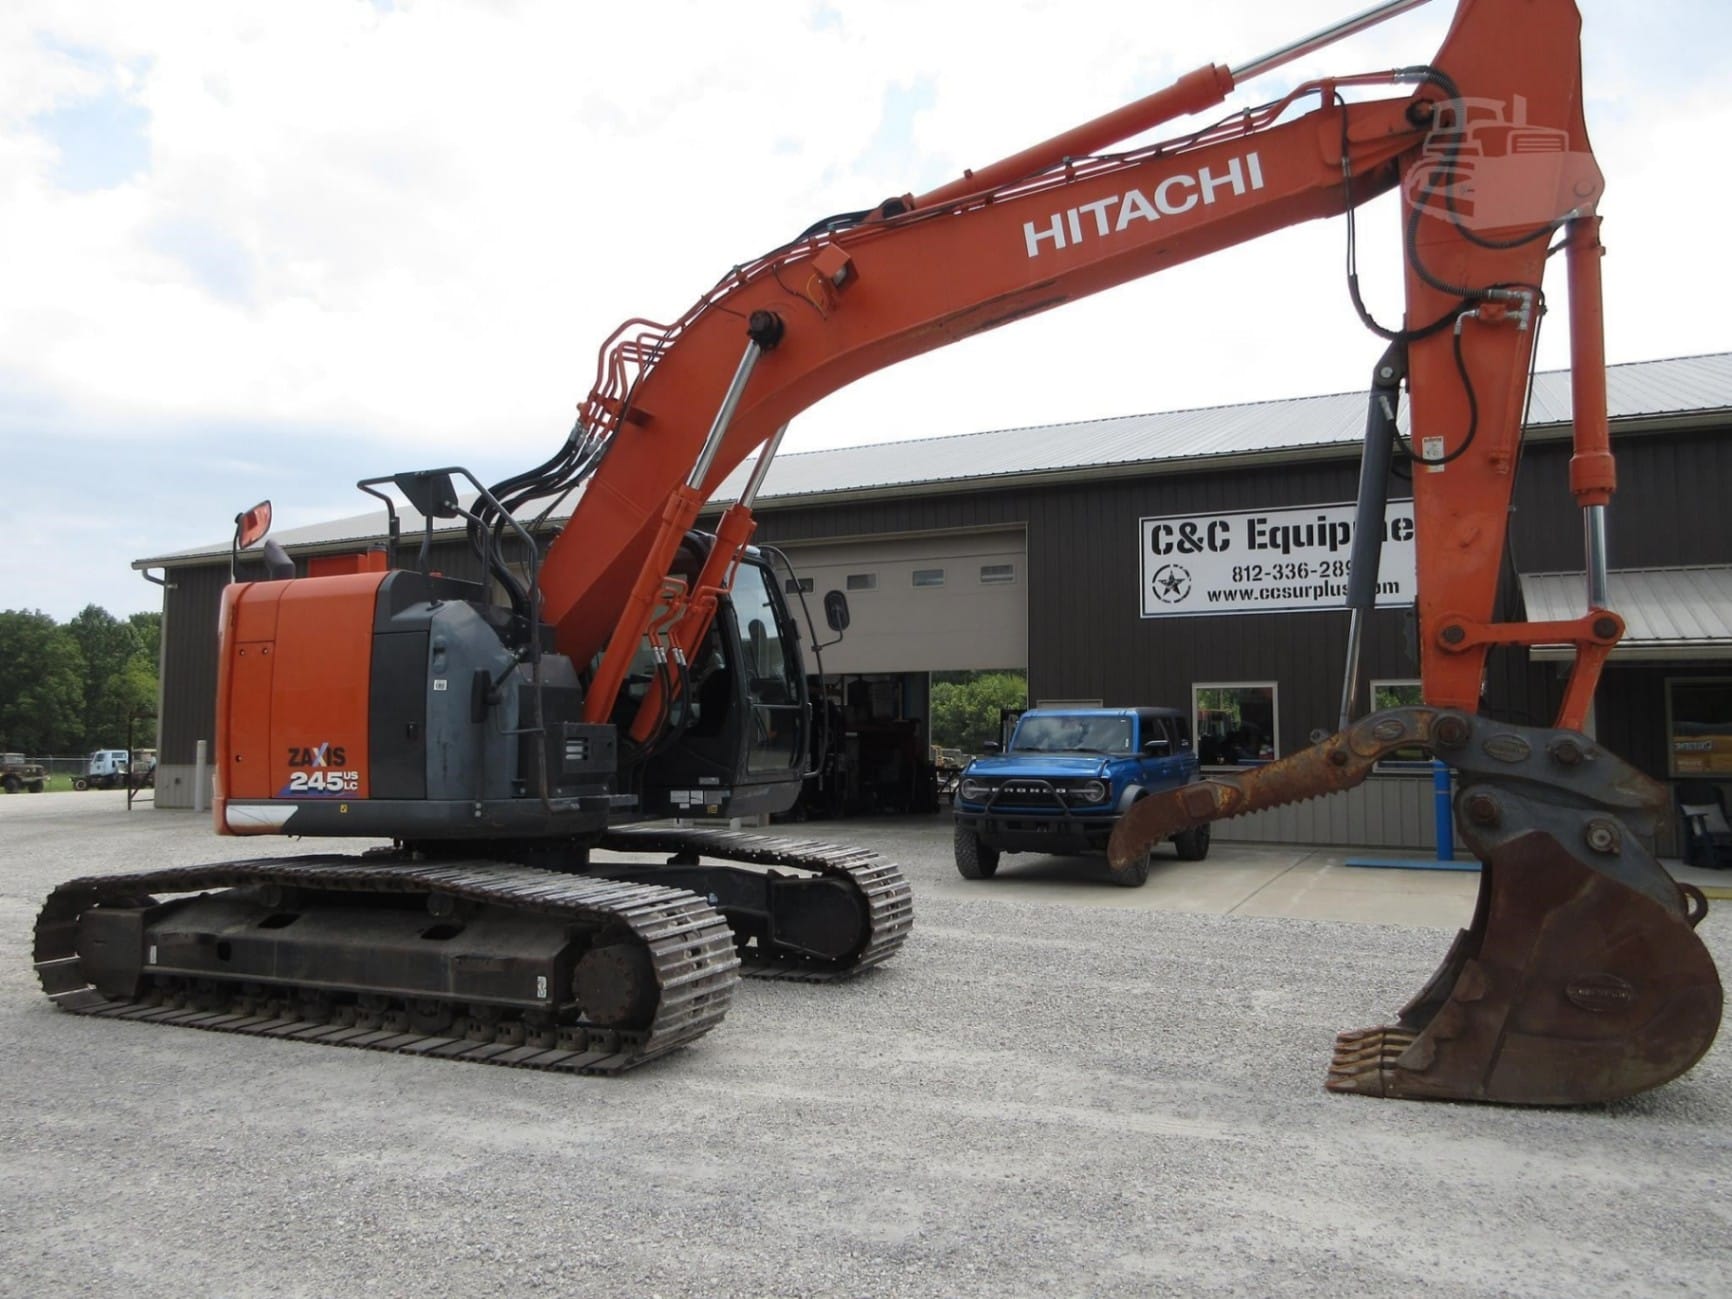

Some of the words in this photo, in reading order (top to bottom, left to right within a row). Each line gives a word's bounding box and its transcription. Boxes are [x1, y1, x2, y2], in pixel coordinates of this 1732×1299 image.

[1023, 152, 1265, 258] HITACHI
[1151, 520, 1231, 556] C&C
[1247, 514, 1414, 555] Equipe
[288, 742, 346, 768] ZAXIS
[290, 771, 344, 791] 245
